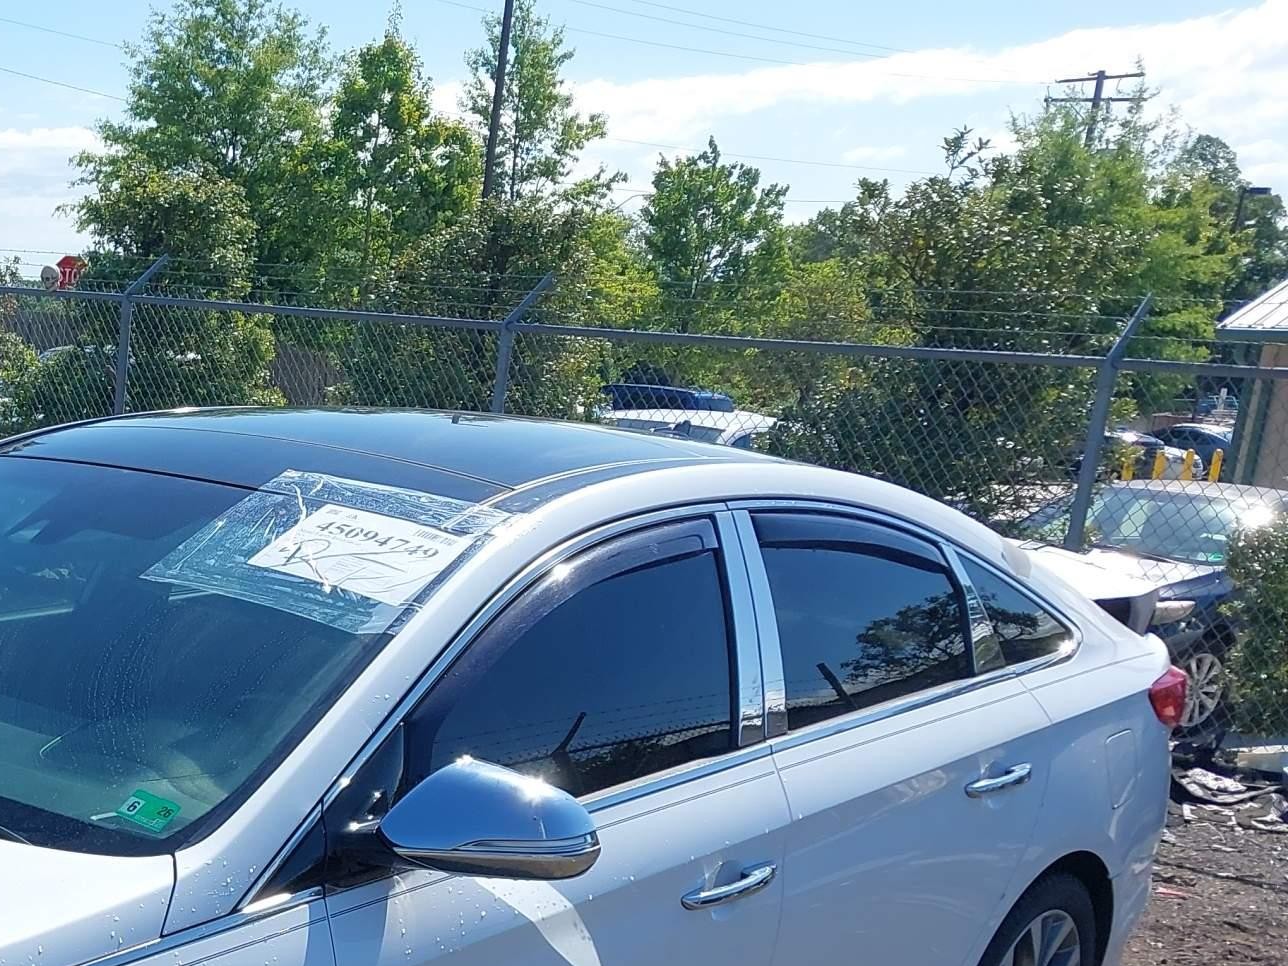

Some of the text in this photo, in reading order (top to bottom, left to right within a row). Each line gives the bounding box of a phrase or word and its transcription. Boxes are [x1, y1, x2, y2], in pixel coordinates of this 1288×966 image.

[316, 521, 440, 558] 45094749
[127, 801, 175, 818] 6 26
